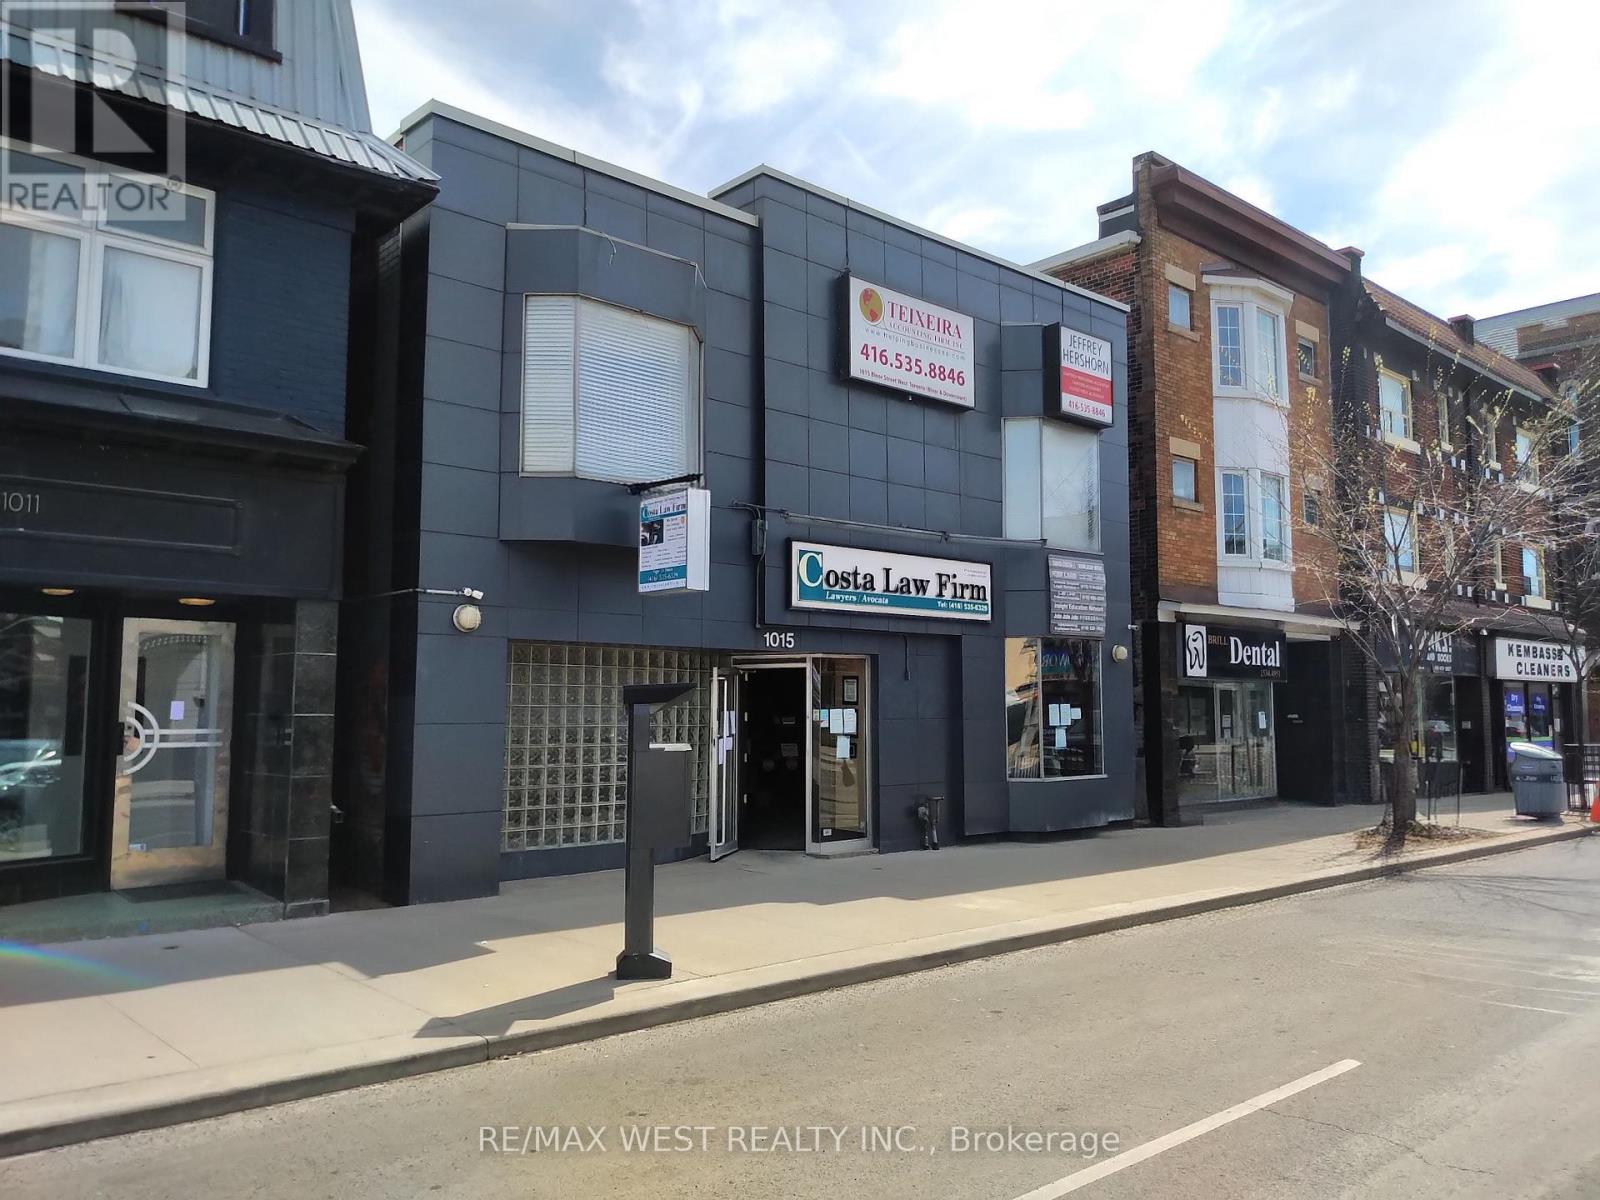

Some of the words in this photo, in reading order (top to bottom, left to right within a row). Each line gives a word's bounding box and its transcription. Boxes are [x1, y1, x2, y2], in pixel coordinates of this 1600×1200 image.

[887, 301, 962, 339] TEIXEIRA
[1068, 334, 1102, 356] JEFFREY
[860, 343, 966, 387] 416.535.8846
[1063, 348, 1109, 376] HERSHORN
[3, 492, 40, 513] 1011
[799, 552, 876, 592] Costa
[882, 567, 931, 596] Law
[935, 572, 988, 601] Firm
[825, 591, 857, 603] Lawyers
[937, 601, 949, 609] Tel:
[764, 631, 795, 648] 1015
[1229, 636, 1280, 667] Dental
[1516, 662, 1570, 677] CLEANERS
